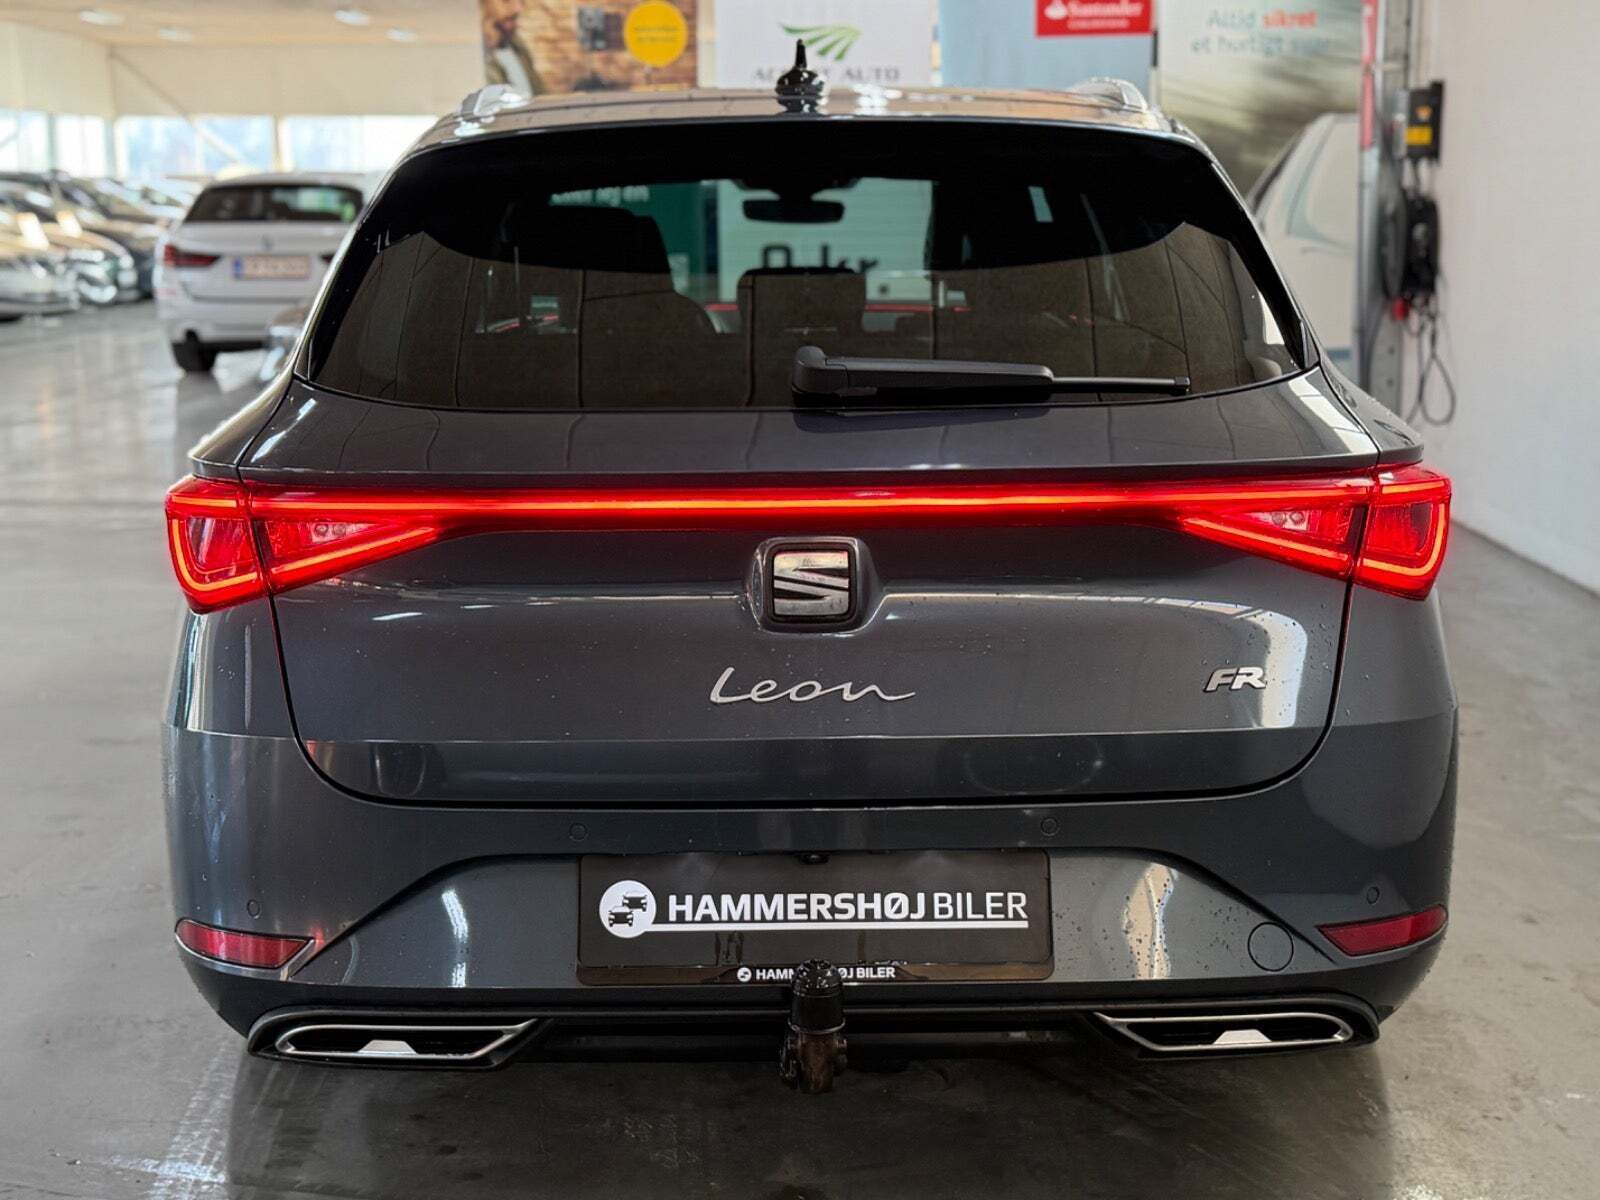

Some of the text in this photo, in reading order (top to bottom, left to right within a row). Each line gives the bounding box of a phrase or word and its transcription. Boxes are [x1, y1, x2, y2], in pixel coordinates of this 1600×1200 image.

[710, 666, 916, 703] Leon
[1203, 667, 1266, 692] FR
[668, 892, 1029, 922] HAMMERSHØJ BILER
[856, 966, 896, 979] BILER
